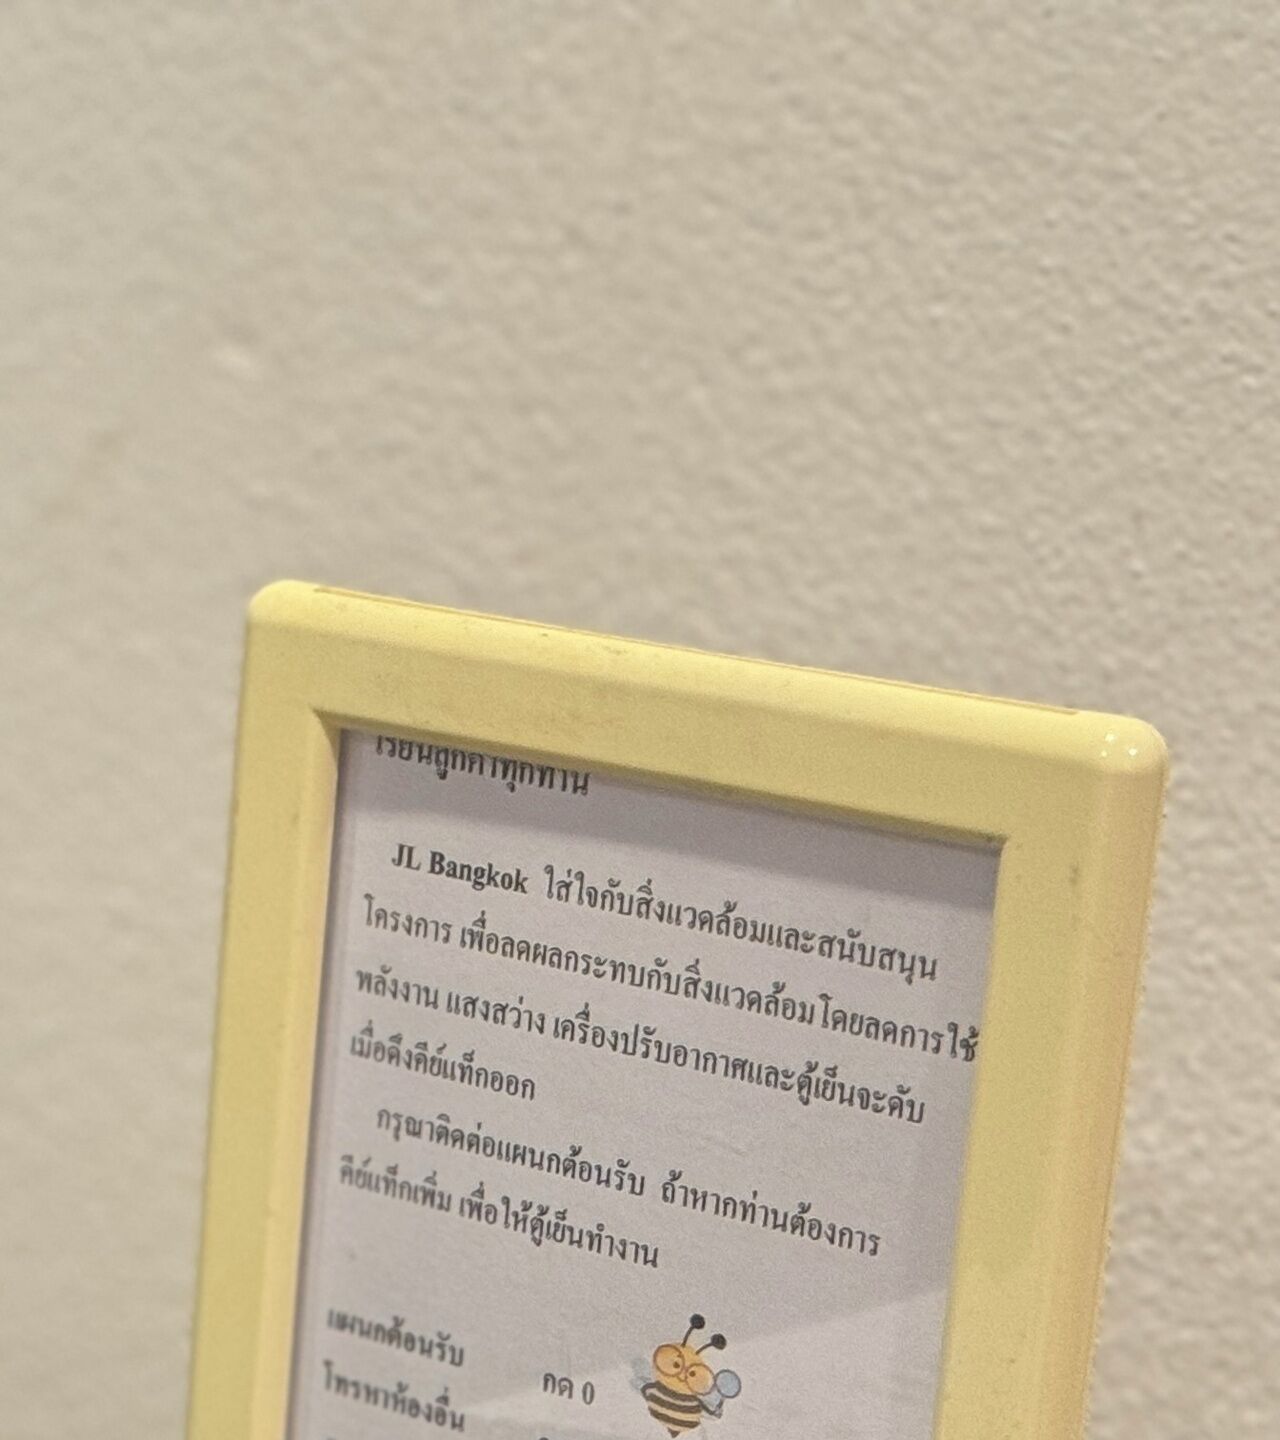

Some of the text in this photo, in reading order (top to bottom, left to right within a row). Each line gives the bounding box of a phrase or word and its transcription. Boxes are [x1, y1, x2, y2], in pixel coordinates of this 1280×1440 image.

[390, 842, 423, 872] JL
[426, 849, 530, 895] Bangkok
[363, 892, 454, 945] โครงการ
[355, 963, 440, 1011] พลังงาน
[445, 991, 547, 1036] แสงสว่าง
[542, 1372, 575, 1400] กด
[581, 1380, 596, 1406] 0
